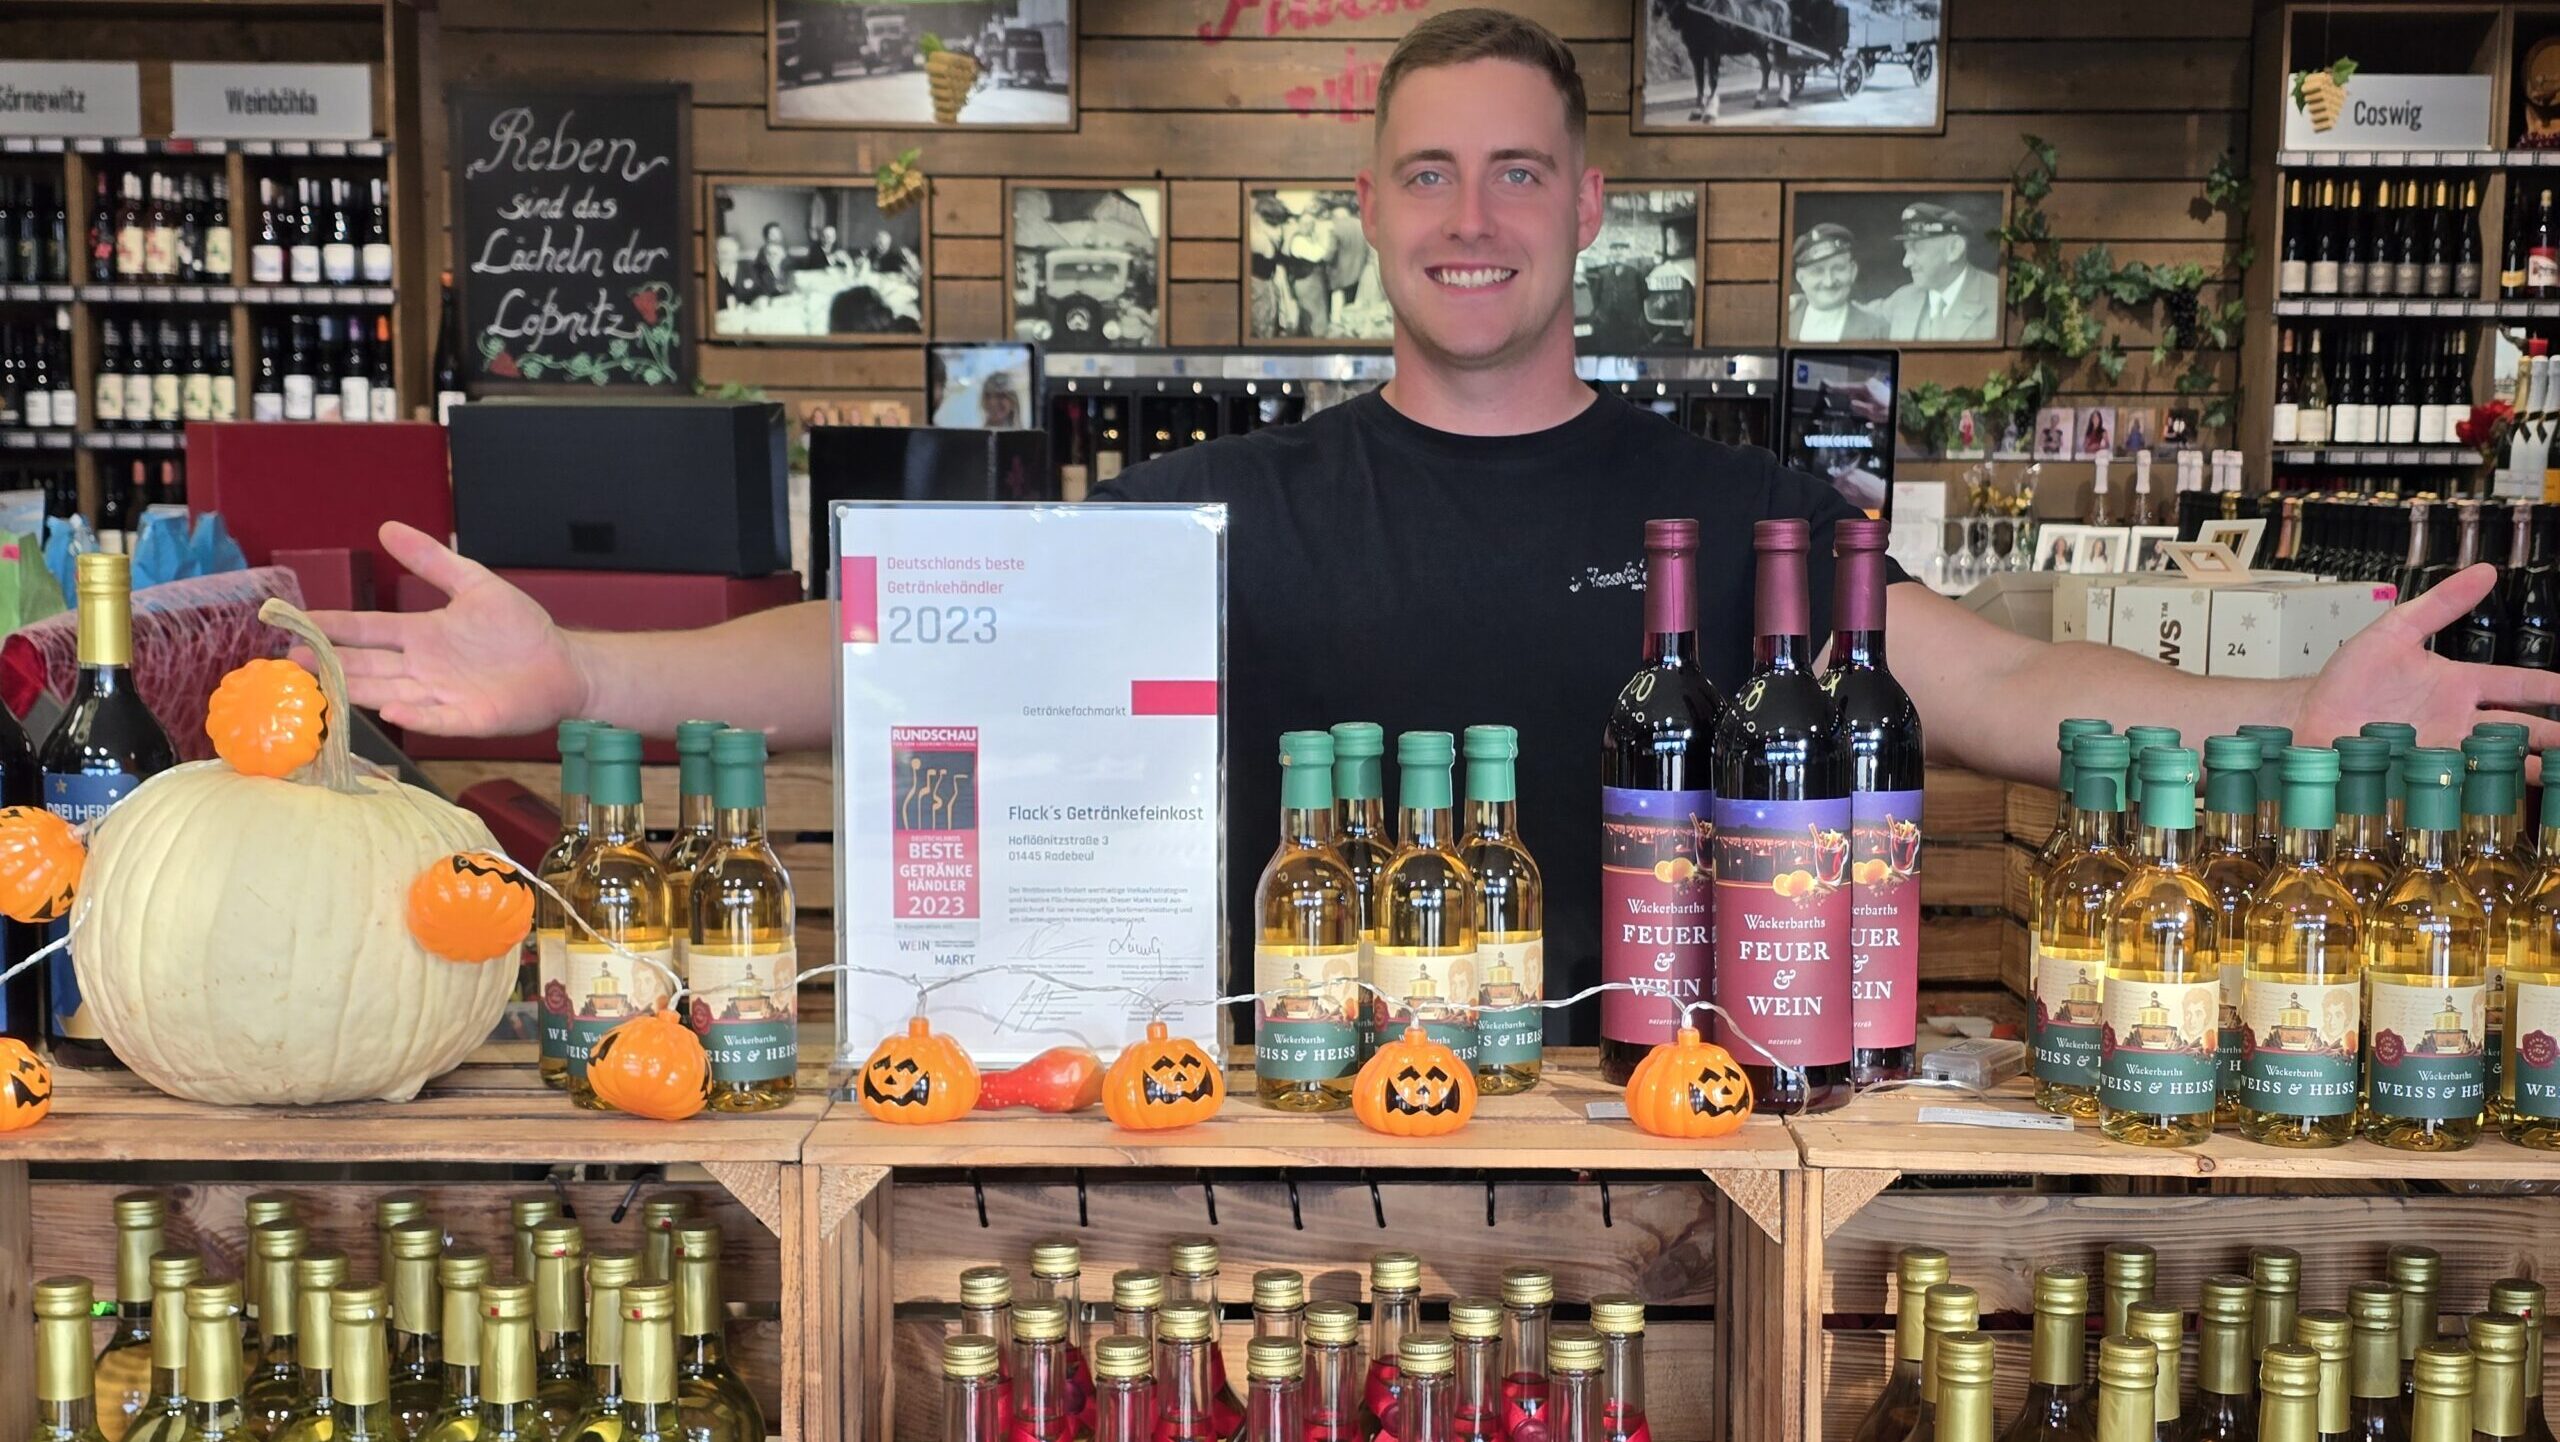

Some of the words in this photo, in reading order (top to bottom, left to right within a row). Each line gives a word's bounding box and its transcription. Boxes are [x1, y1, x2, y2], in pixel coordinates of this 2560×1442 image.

[2354, 99, 2423, 131] Coswig
[465, 107, 669, 182] Reben
[497, 186, 570, 220] sind
[572, 186, 618, 219] das
[471, 225, 603, 277] Lächeln
[612, 229, 669, 274] der
[487, 288, 643, 352] Lößnitz
[887, 556, 981, 570] Deutschlands
[985, 556, 1025, 570] beste
[887, 580, 1004, 594] Getränkehändler
[888, 605, 997, 644] 2023
[2063, 620, 2072, 634] 14
[2227, 642, 2247, 657] 24
[2302, 642, 2310, 656] 4
[1022, 705, 1127, 717] Getränkefachmarkt
[892, 729, 977, 741] RUNDSCHAU
[1066, 804, 1205, 821] Getränkefeinkost
[1101, 835, 1109, 846] 3
[909, 843, 964, 859] BESTE
[1008, 851, 1042, 862] 01445
[1044, 851, 1095, 862] Radebeul
[899, 862, 973, 878] GETRÄNKE
[908, 878, 966, 892] HÄNDLER
[908, 896, 965, 916] 2023
[1628, 899, 1705, 914] Wackerbarths
[1853, 903, 1898, 916] erbarths
[1744, 914, 1826, 930] Wackerbarths
[1623, 924, 1709, 945] FEUER
[1852, 927, 1901, 947] UER
[899, 940, 931, 951] WEIN
[1739, 941, 1831, 962] FEUER
[935, 953, 976, 966] MARKT
[1654, 952, 1676, 972] &
[1629, 977, 1702, 998] WEIN
[1773, 969, 1797, 990] &
[1852, 981, 1893, 1000] EIN
[1746, 996, 1822, 1017] WEIN
[1273, 1033, 1325, 1045] Wackerbarths
[1497, 1034, 1511, 1047] &
[747, 1050, 760, 1063] &
[1294, 1050, 1308, 1062] &
[1314, 1045, 1356, 1061] HEISS
[2077, 1055, 2090, 1067] &
[2126, 1062, 2184, 1077] Wackerbarths
[2265, 1063, 2323, 1078] Wackerbarths
[2418, 1069, 2473, 1081] Wackerbarths
[2148, 1082, 2163, 1095] &
[2170, 1079, 2214, 1096] HEISS
[2288, 1083, 2302, 1095] &
[2310, 1080, 2355, 1096] HEISS
[2377, 1081, 2436, 1099] WEISS
[2442, 1086, 2456, 1099] &
